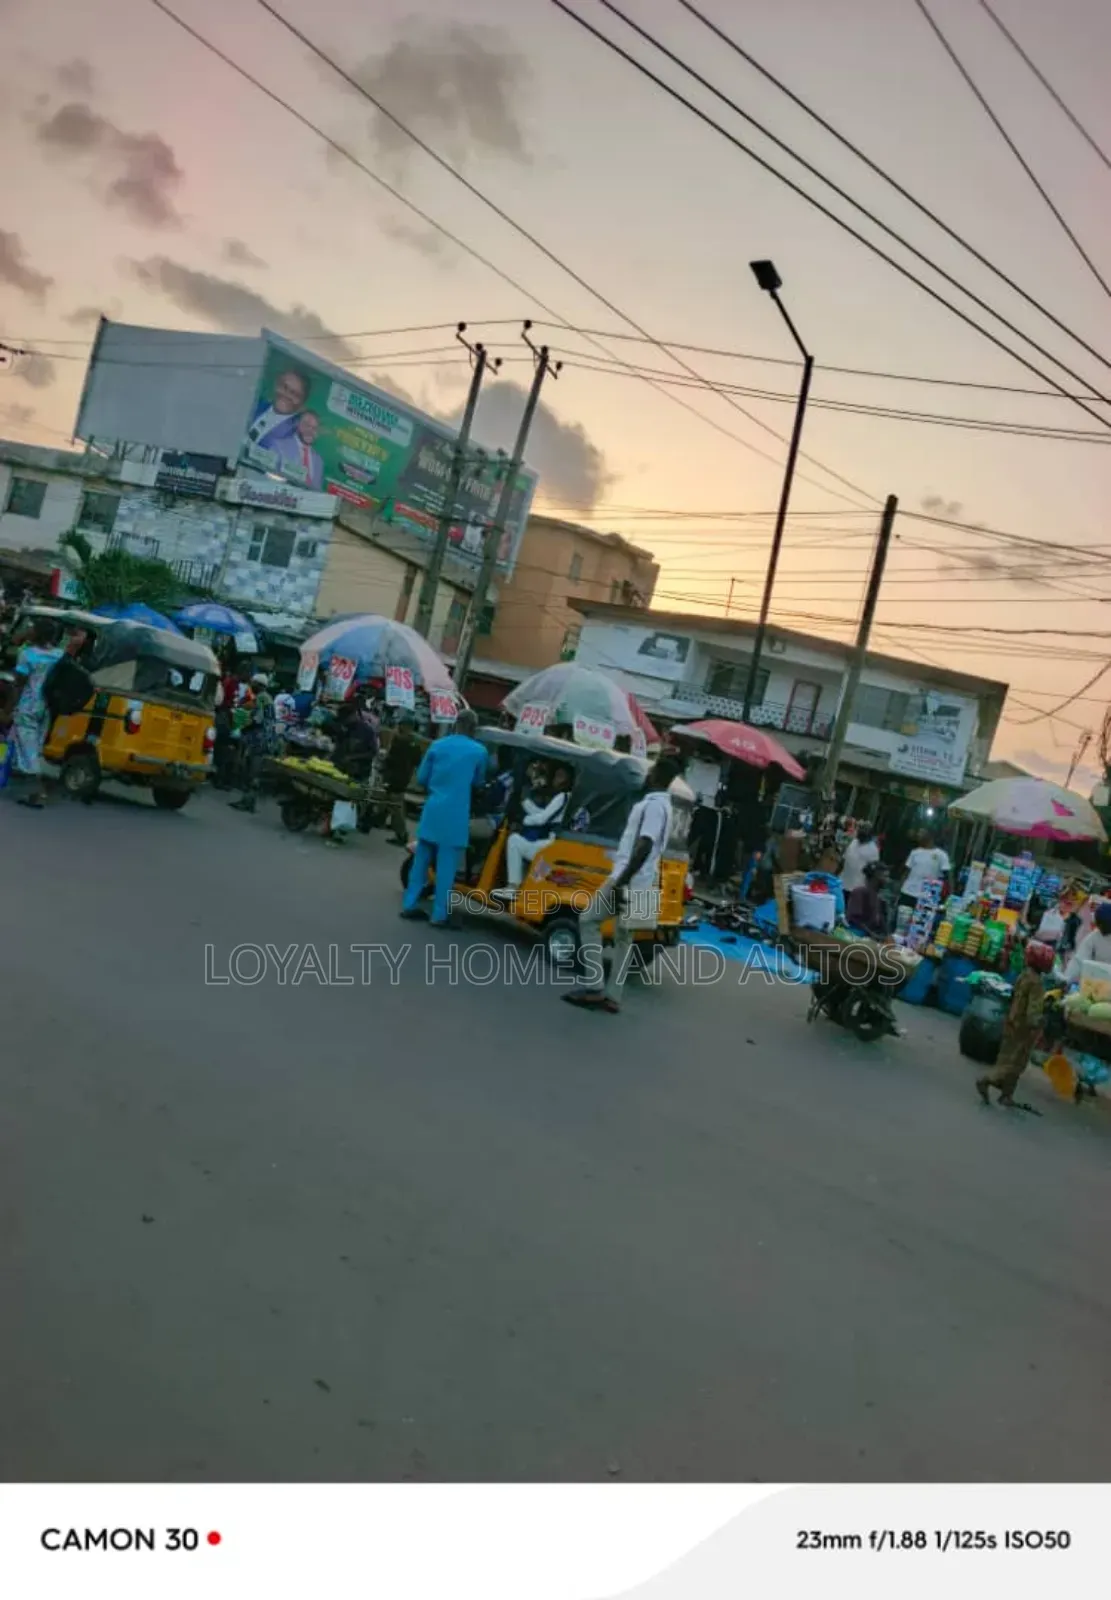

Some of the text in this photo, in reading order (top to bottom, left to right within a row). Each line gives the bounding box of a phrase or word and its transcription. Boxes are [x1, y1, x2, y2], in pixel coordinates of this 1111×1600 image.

[331, 655, 356, 681] POS
[387, 666, 413, 690] POS
[430, 695, 458, 717] POS
[521, 706, 548, 728] POS
[576, 720, 613, 740] POS
